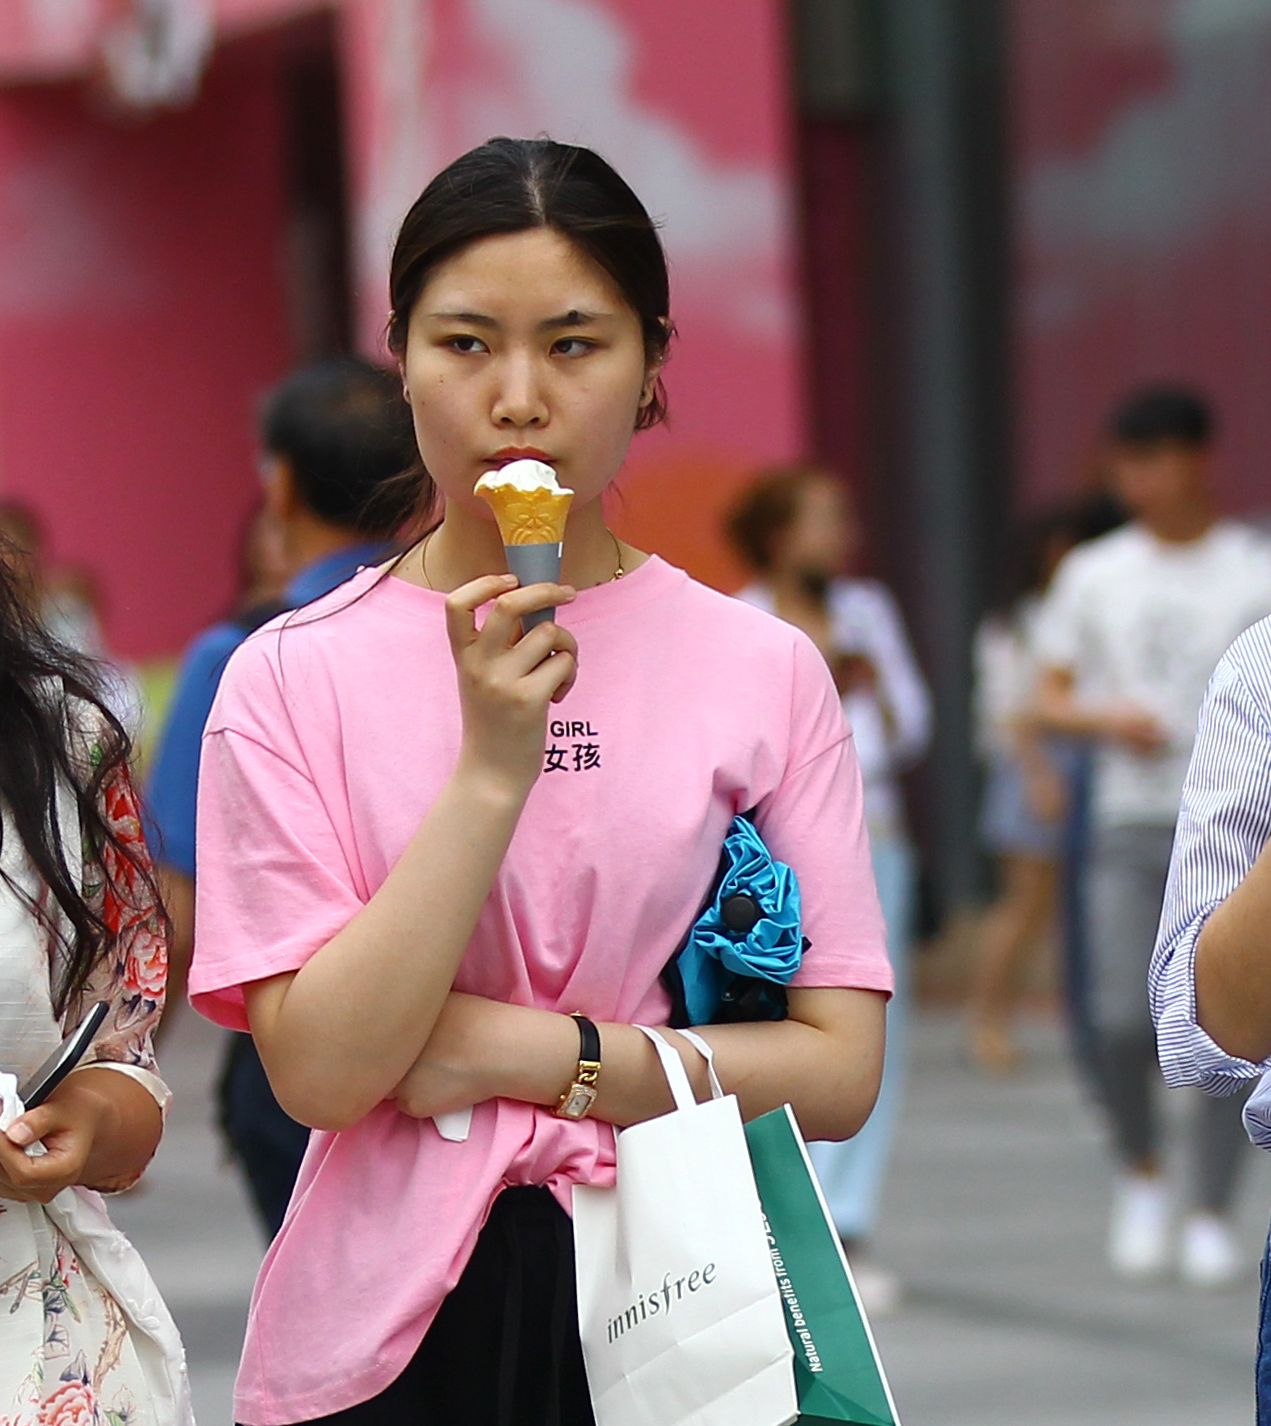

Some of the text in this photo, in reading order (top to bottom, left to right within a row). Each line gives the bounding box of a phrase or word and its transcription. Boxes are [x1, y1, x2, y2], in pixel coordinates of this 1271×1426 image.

[550, 720, 599, 738] GIRL
[544, 742, 601, 773] 女孩
[607, 1262, 717, 1344] innisfree
[770, 1248, 824, 1373] Natural benefits from
